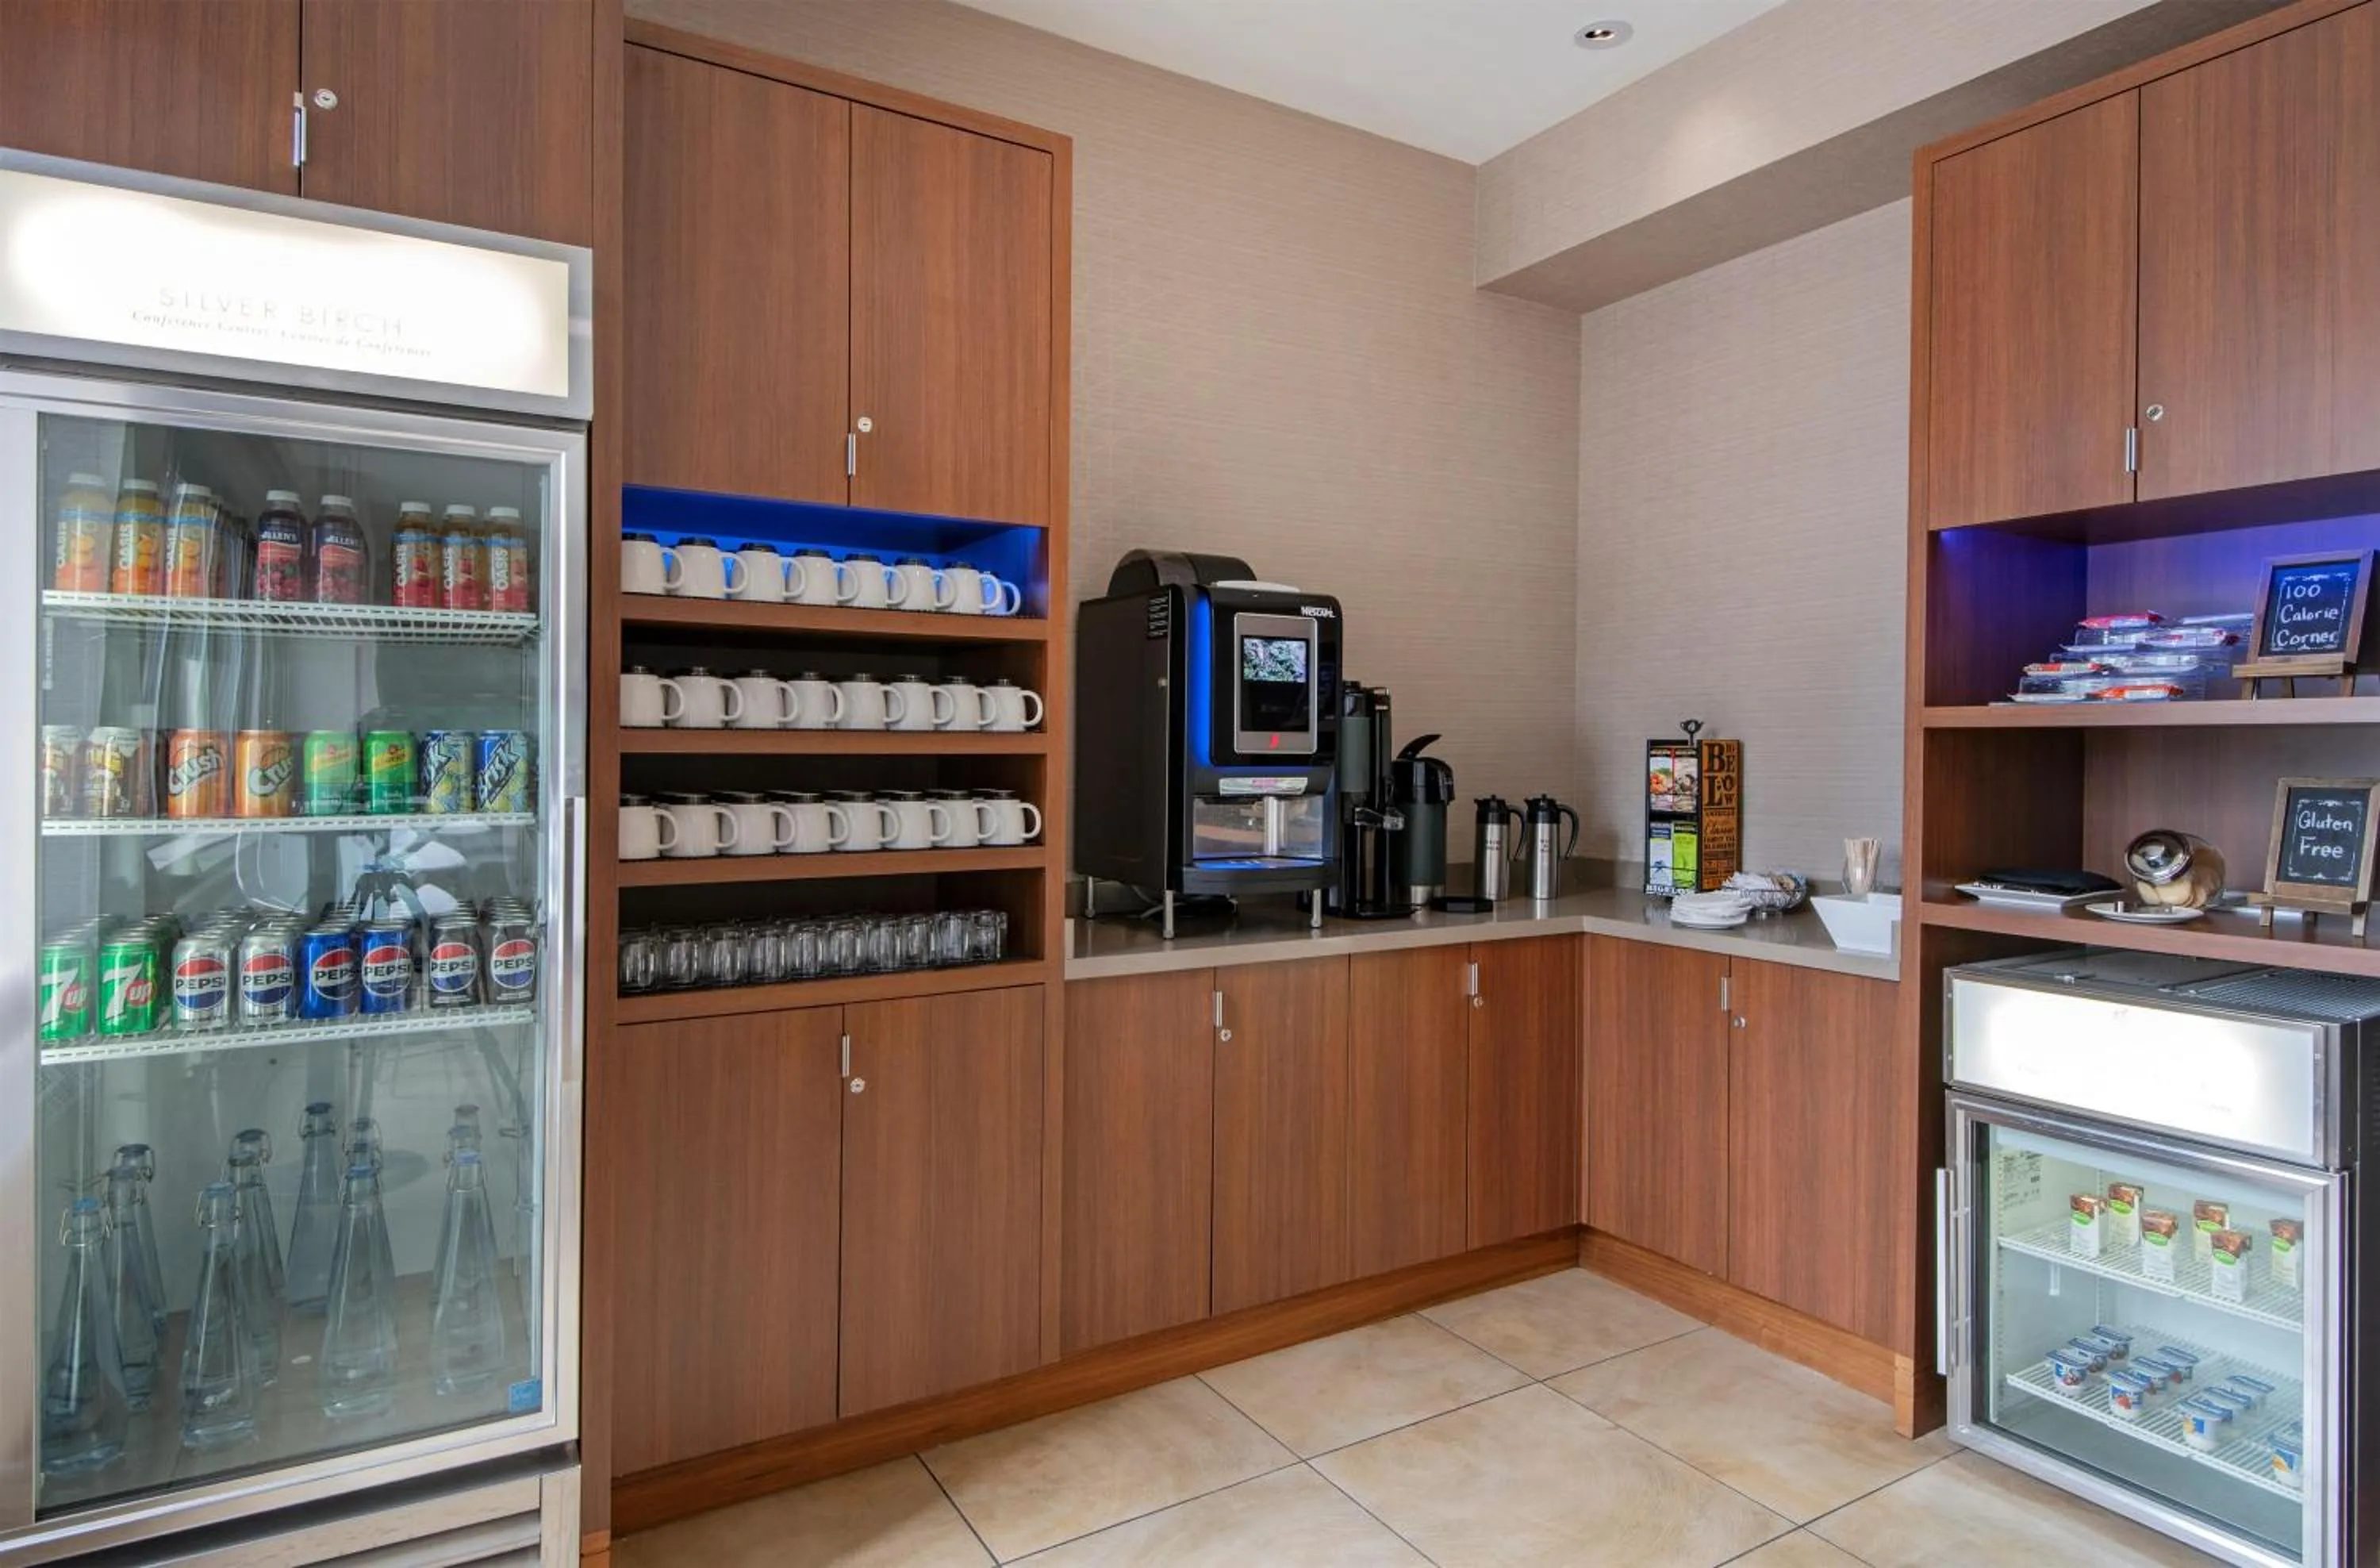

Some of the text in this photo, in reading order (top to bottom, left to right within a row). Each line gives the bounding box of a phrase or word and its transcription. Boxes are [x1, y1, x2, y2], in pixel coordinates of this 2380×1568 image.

[159, 286, 404, 337] SILVER BIRCH
[119, 523, 134, 570] OASIS
[396, 543, 407, 586] OASIS
[443, 546, 454, 590] OASIS
[495, 548, 509, 591] OASIS
[2286, 585, 2320, 599] 100
[2280, 604, 2339, 624] Calorie
[2276, 629, 2339, 647] Corner
[169, 748, 224, 794] Crush
[249, 756, 294, 795] Cru
[2298, 810, 2353, 832] Gluten
[2301, 836, 2344, 859] Free
[315, 967, 356, 981] PEPS
[365, 963, 411, 977] PEPSI
[431, 959, 474, 973] PEPSI
[495, 957, 533, 970] PEPS
[175, 977, 226, 990] PEPSI
[243, 972, 293, 986] PEPSI
